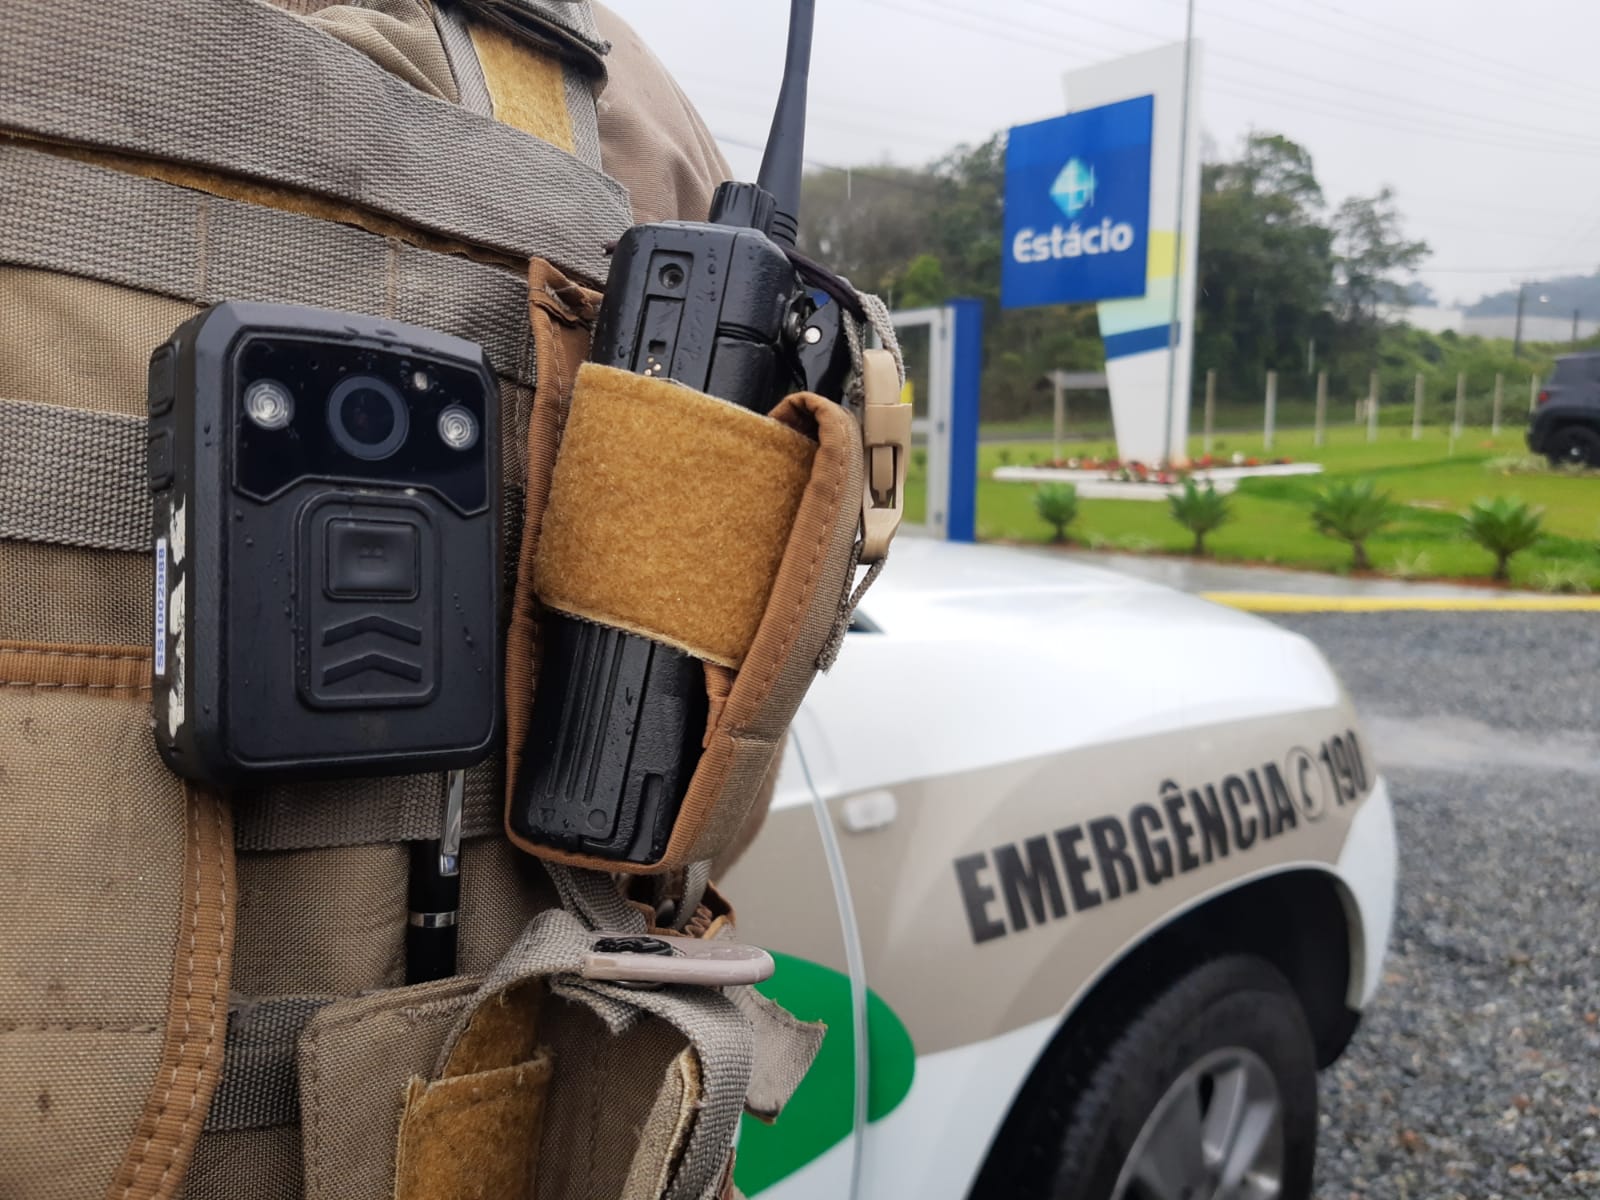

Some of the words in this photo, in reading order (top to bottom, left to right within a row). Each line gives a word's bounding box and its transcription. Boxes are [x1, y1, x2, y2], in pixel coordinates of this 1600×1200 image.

[1012, 217, 1134, 264] Estácio
[953, 761, 1297, 945] EMERGÊNCIA
[1319, 729, 1368, 805] 190
